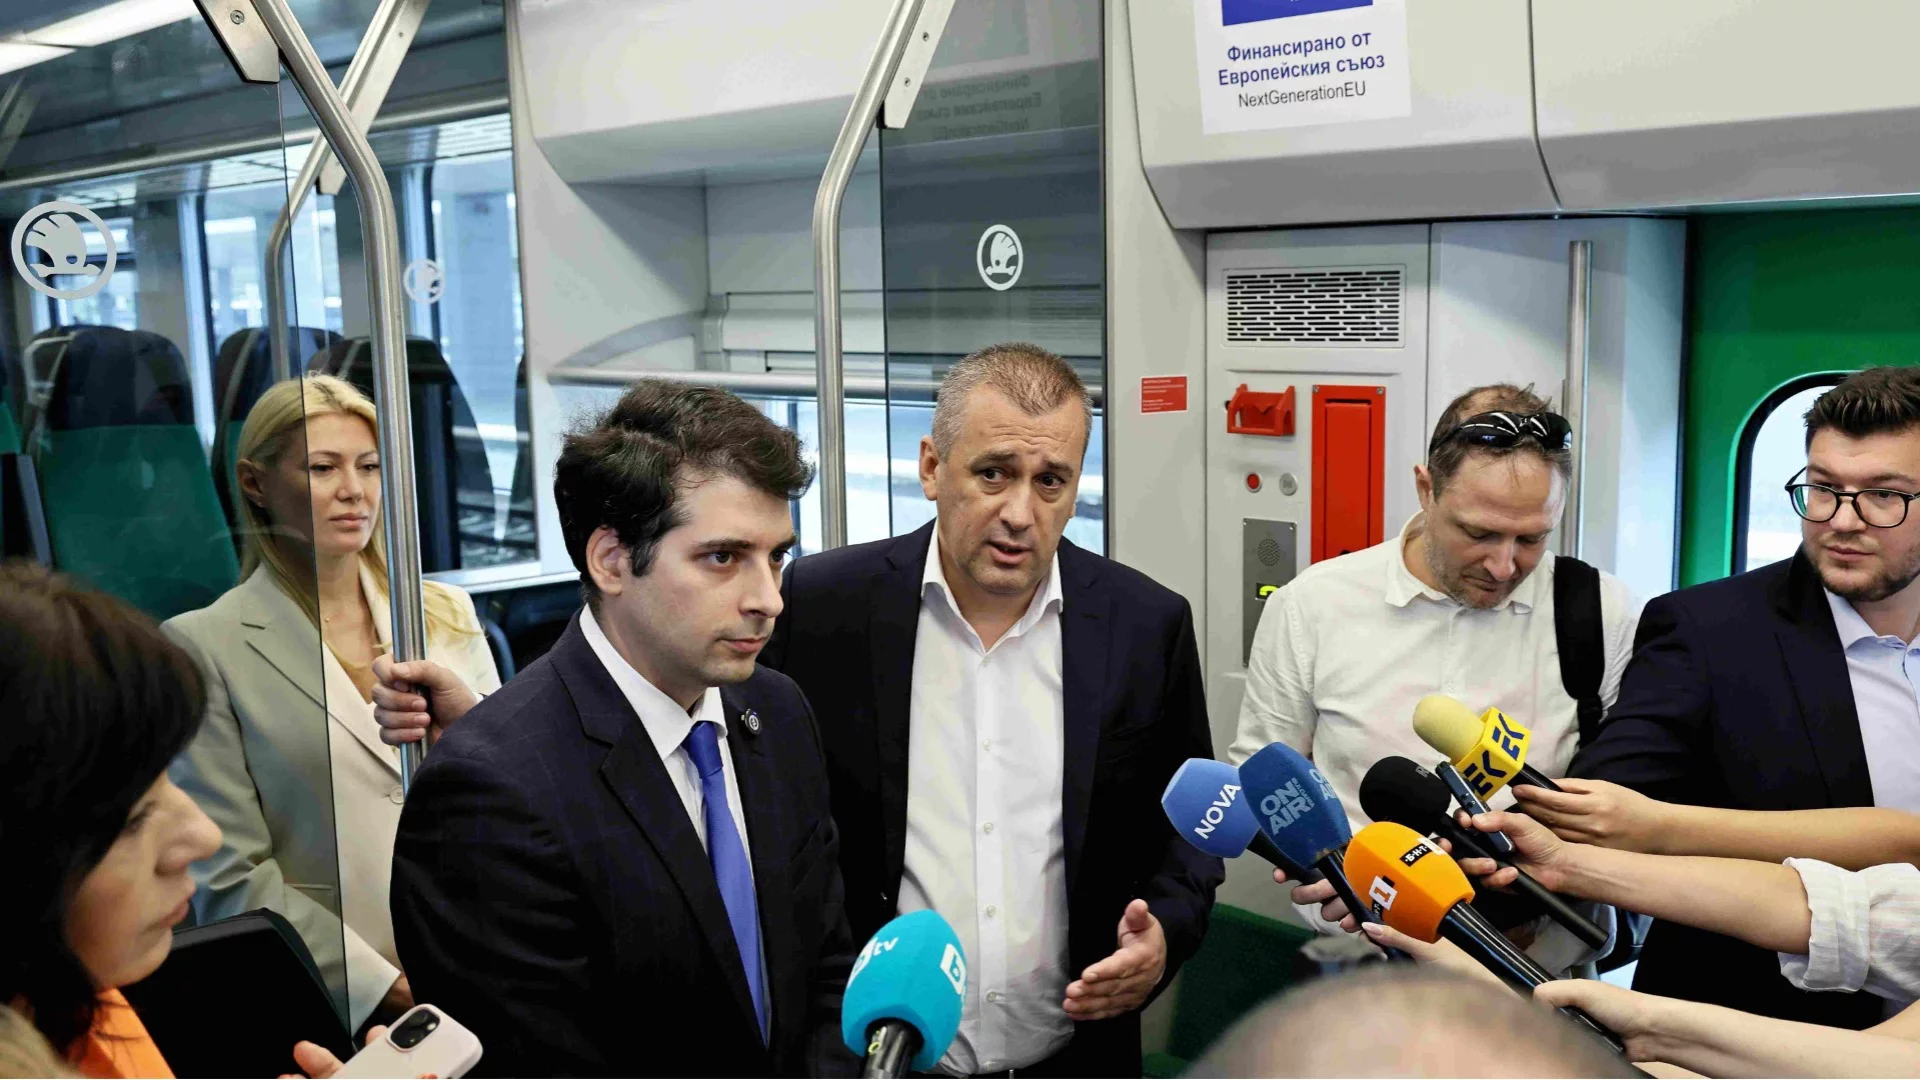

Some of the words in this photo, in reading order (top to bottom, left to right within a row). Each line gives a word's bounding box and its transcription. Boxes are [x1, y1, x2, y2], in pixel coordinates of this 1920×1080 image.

[1227, 36, 1346, 62] Финансирано
[1351, 32, 1371, 47] от
[1218, 61, 1331, 87] Европейския
[1336, 55, 1385, 73] съюз
[1238, 80, 1367, 108] NextGenerationEU
[1194, 783, 1242, 840] NOVA
[1260, 780, 1300, 816] ON
[1269, 796, 1313, 836] AIR
